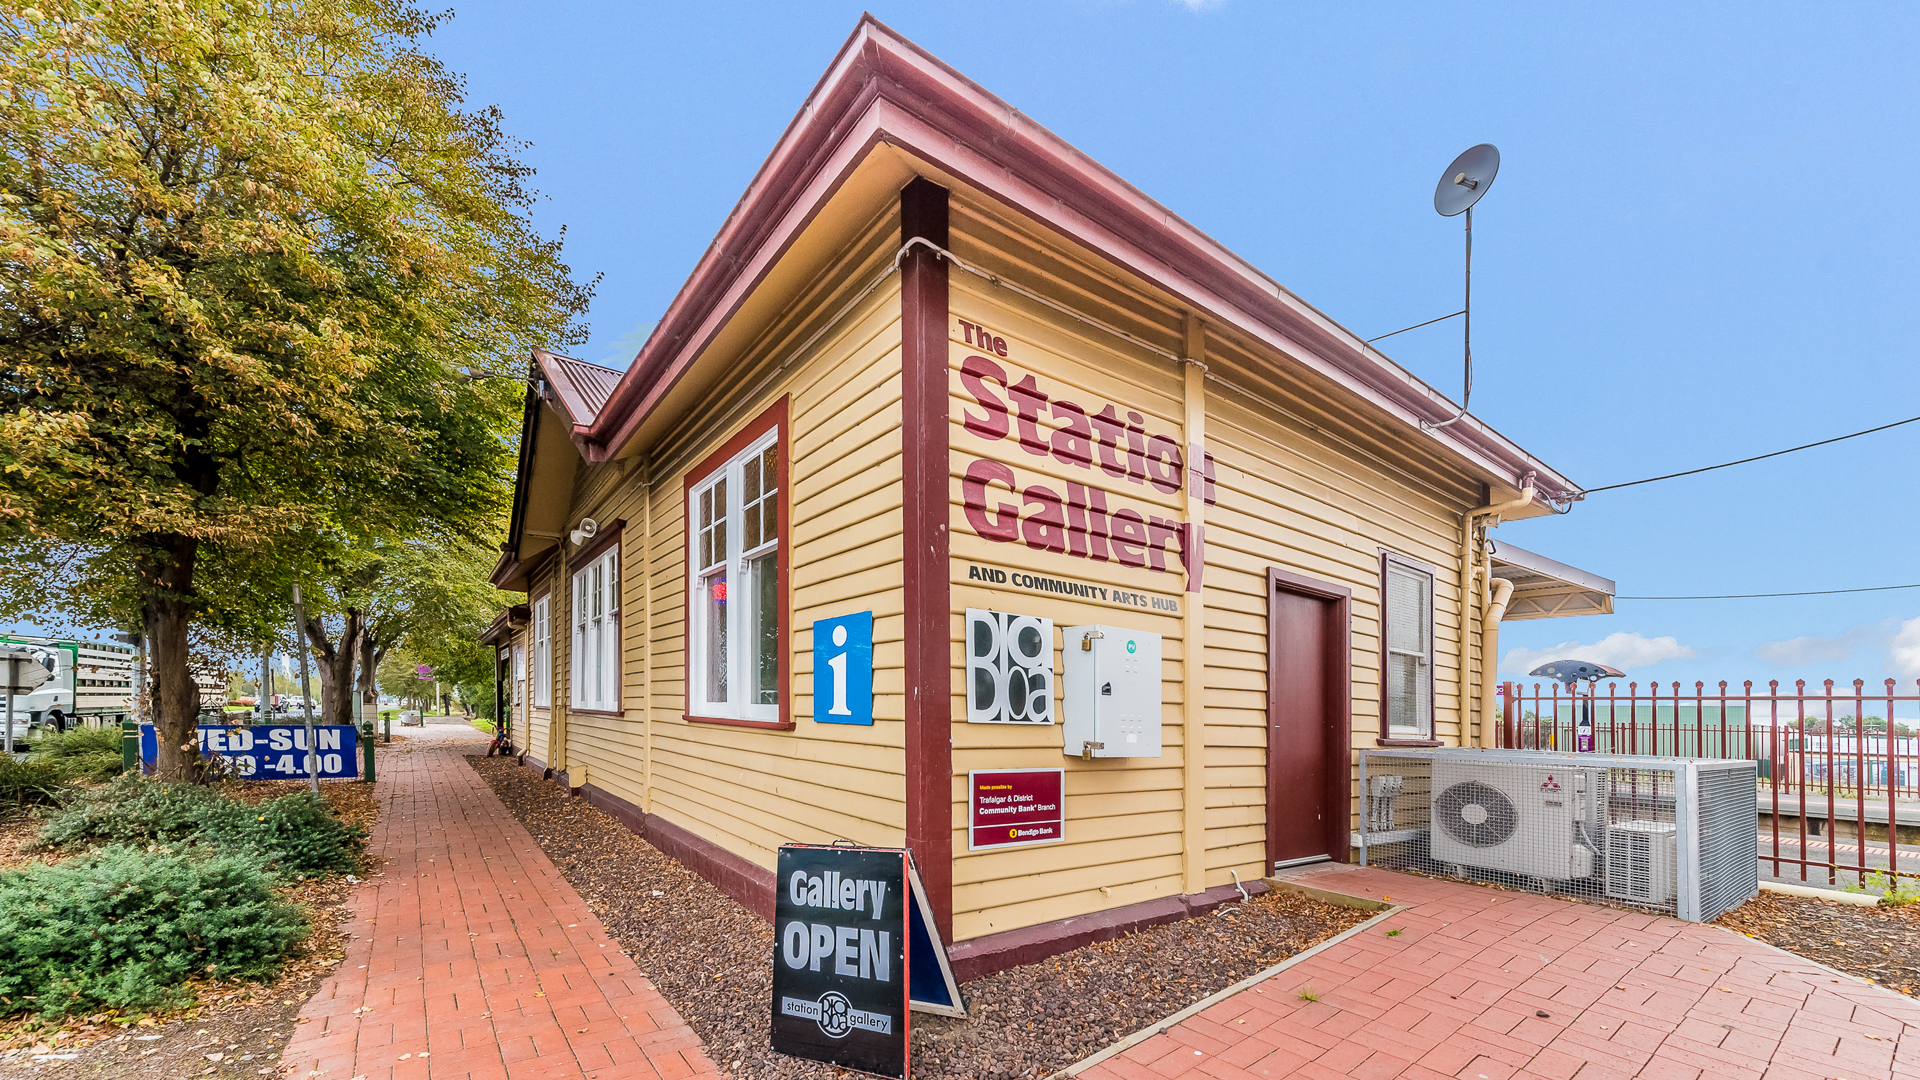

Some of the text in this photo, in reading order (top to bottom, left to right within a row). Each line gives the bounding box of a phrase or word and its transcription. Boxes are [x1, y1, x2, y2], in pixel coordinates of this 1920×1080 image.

[958, 319, 1008, 357] The
[960, 355, 1217, 508] Station
[962, 459, 1206, 593] Gallery
[969, 565, 1178, 612] AND COMMUNITY ARTS HUB
[198, 728, 341, 751] ED-SUN
[979, 796, 1006, 805] Trafalgar
[1013, 794, 1034, 802] District
[979, 806, 1017, 815] Community
[1037, 803, 1056, 811] Branch
[1017, 827, 1053, 837] Bendigo Bank
[789, 870, 887, 920] Gallery
[783, 921, 890, 982] OPEN
[787, 1002, 888, 1031] station gallery
